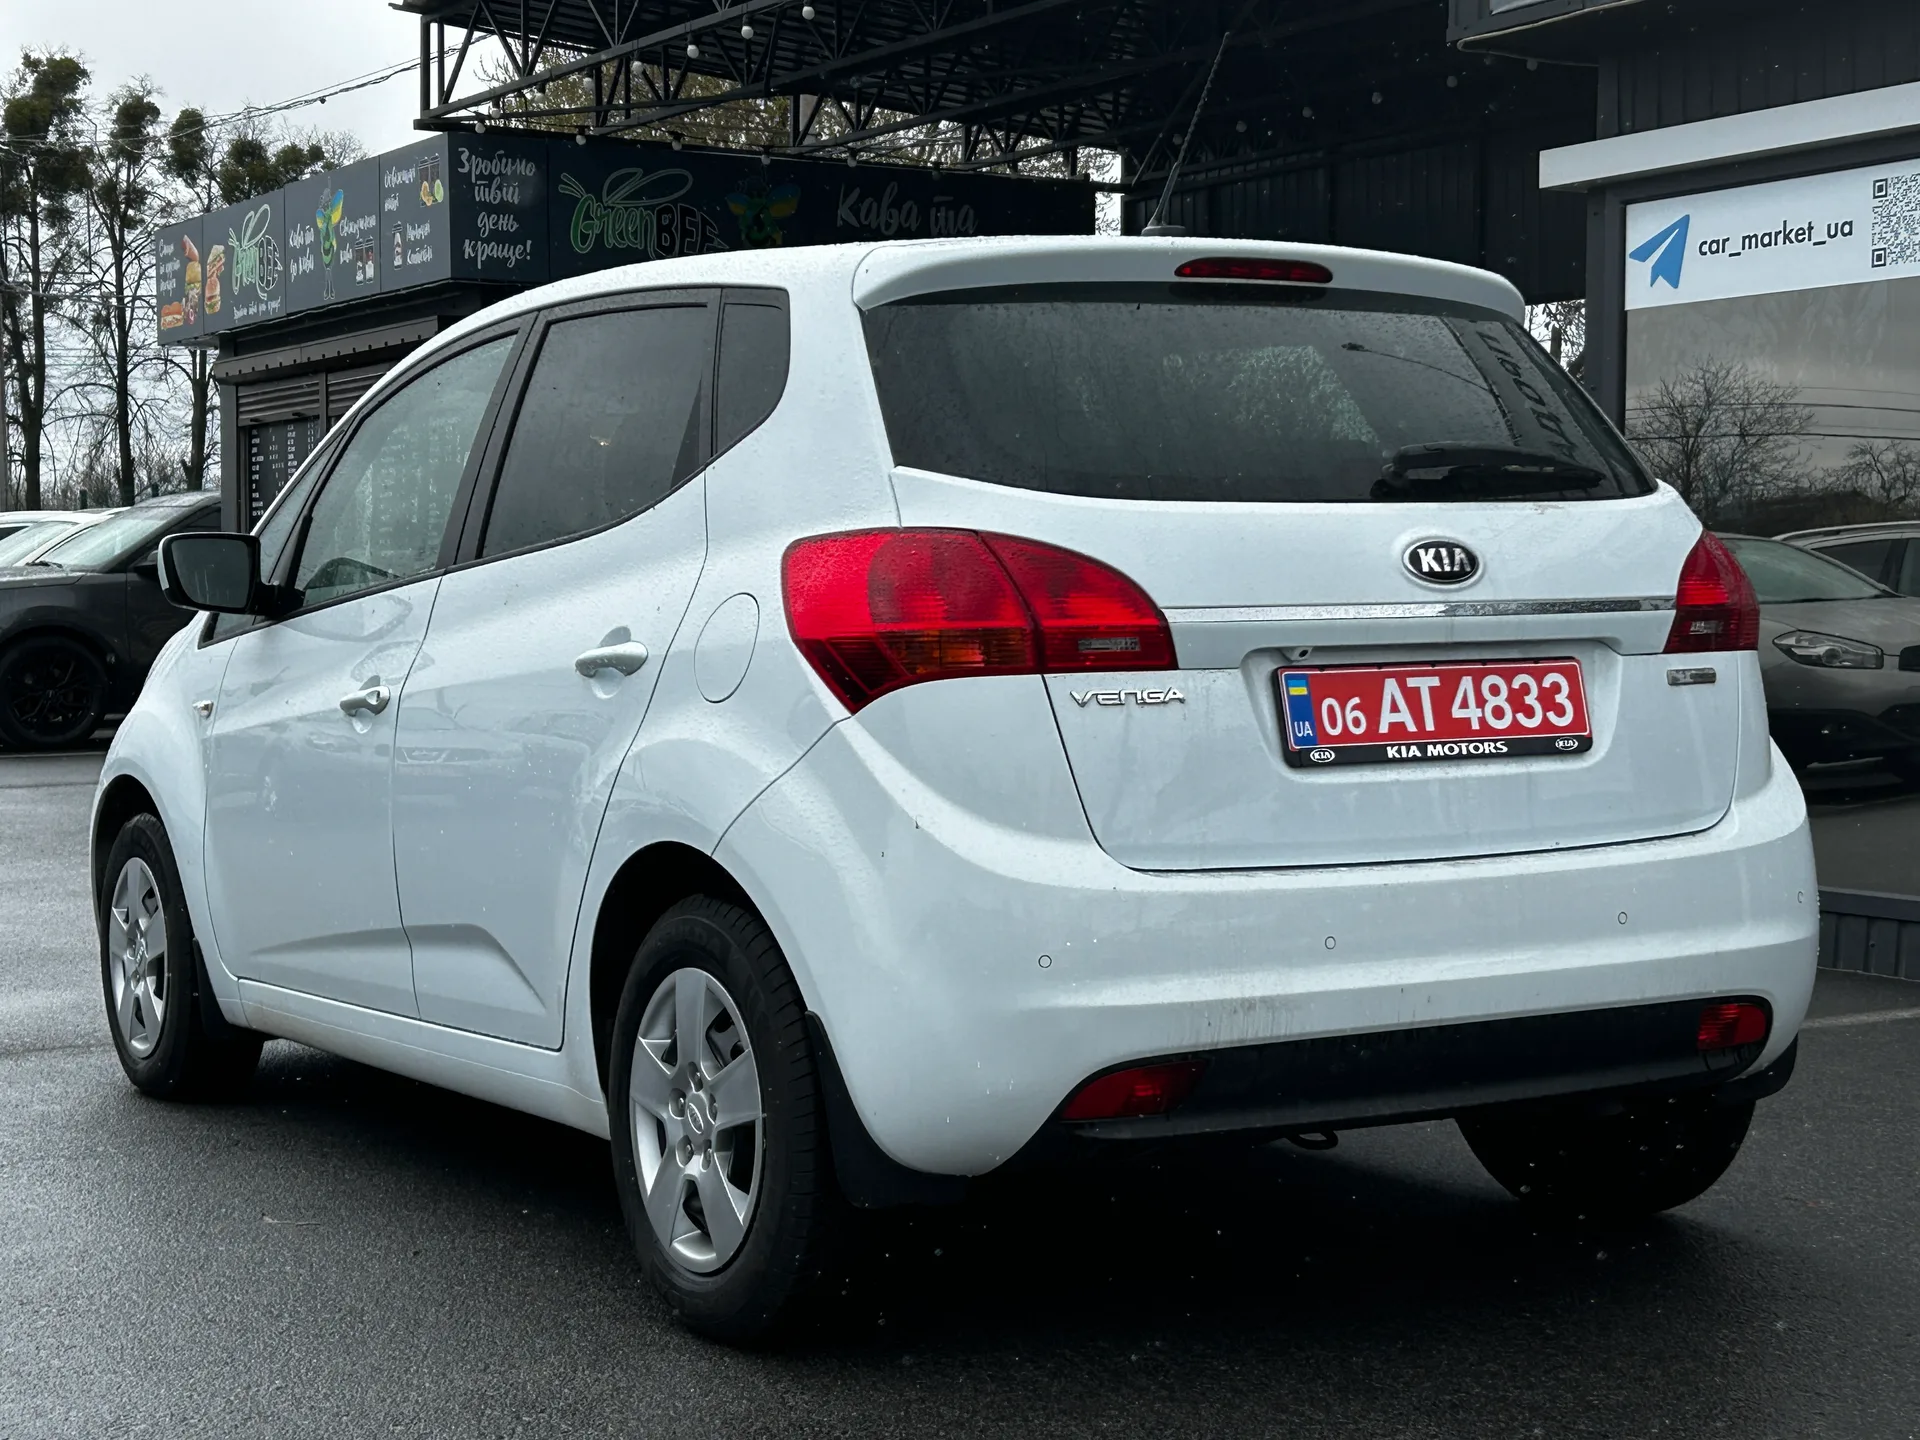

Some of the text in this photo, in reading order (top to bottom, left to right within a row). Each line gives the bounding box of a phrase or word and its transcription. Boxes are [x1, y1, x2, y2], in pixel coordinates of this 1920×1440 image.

[457, 147, 536, 184] Зробимо
[474, 176, 521, 205] твій
[835, 180, 979, 236] Кава та
[477, 211, 520, 238] день
[1698, 220, 1854, 257] car_market_ua
[463, 239, 533, 270] краще!
[1416, 547, 1472, 573] KIA
[1321, 672, 1574, 736] 06 AT 4833
[1294, 721, 1313, 738] UA
[1312, 750, 1332, 760] KIA
[1386, 740, 1509, 759] KIA MOTORS
